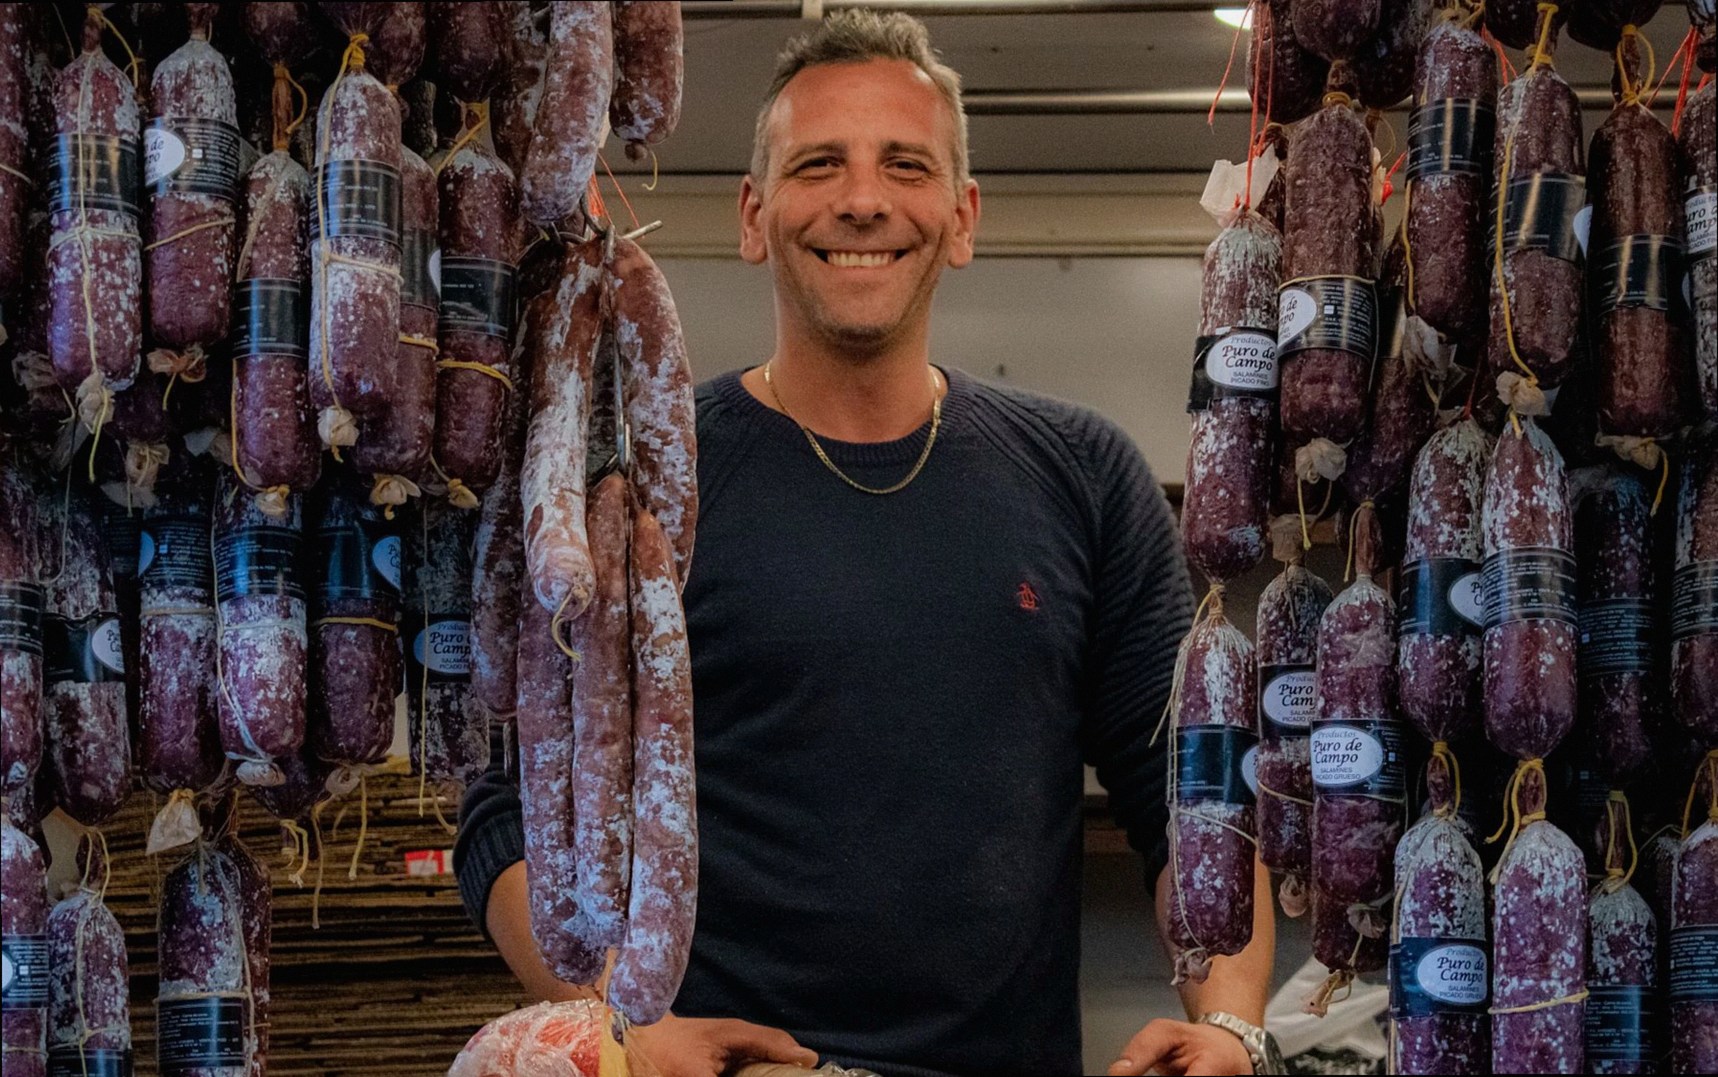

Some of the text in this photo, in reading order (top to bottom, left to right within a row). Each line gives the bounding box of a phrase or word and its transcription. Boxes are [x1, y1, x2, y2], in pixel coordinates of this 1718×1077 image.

[1286, 296, 1298, 311] de
[1222, 345, 1276, 360] Puro de
[1226, 356, 1272, 372] Campo
[1233, 371, 1268, 380] SALAMINES
[430, 631, 463, 643] Puro
[434, 642, 471, 658] Camp
[1278, 683, 1314, 695] Puro
[1282, 694, 1316, 710] Cam
[1317, 730, 1356, 739] Productos
[1313, 737, 1362, 752] Puro de
[1315, 751, 1359, 767] Campo
[1437, 956, 1484, 971] Puro de
[1440, 968, 1483, 986] Campo
[1439, 991, 1463, 999] PICADO
